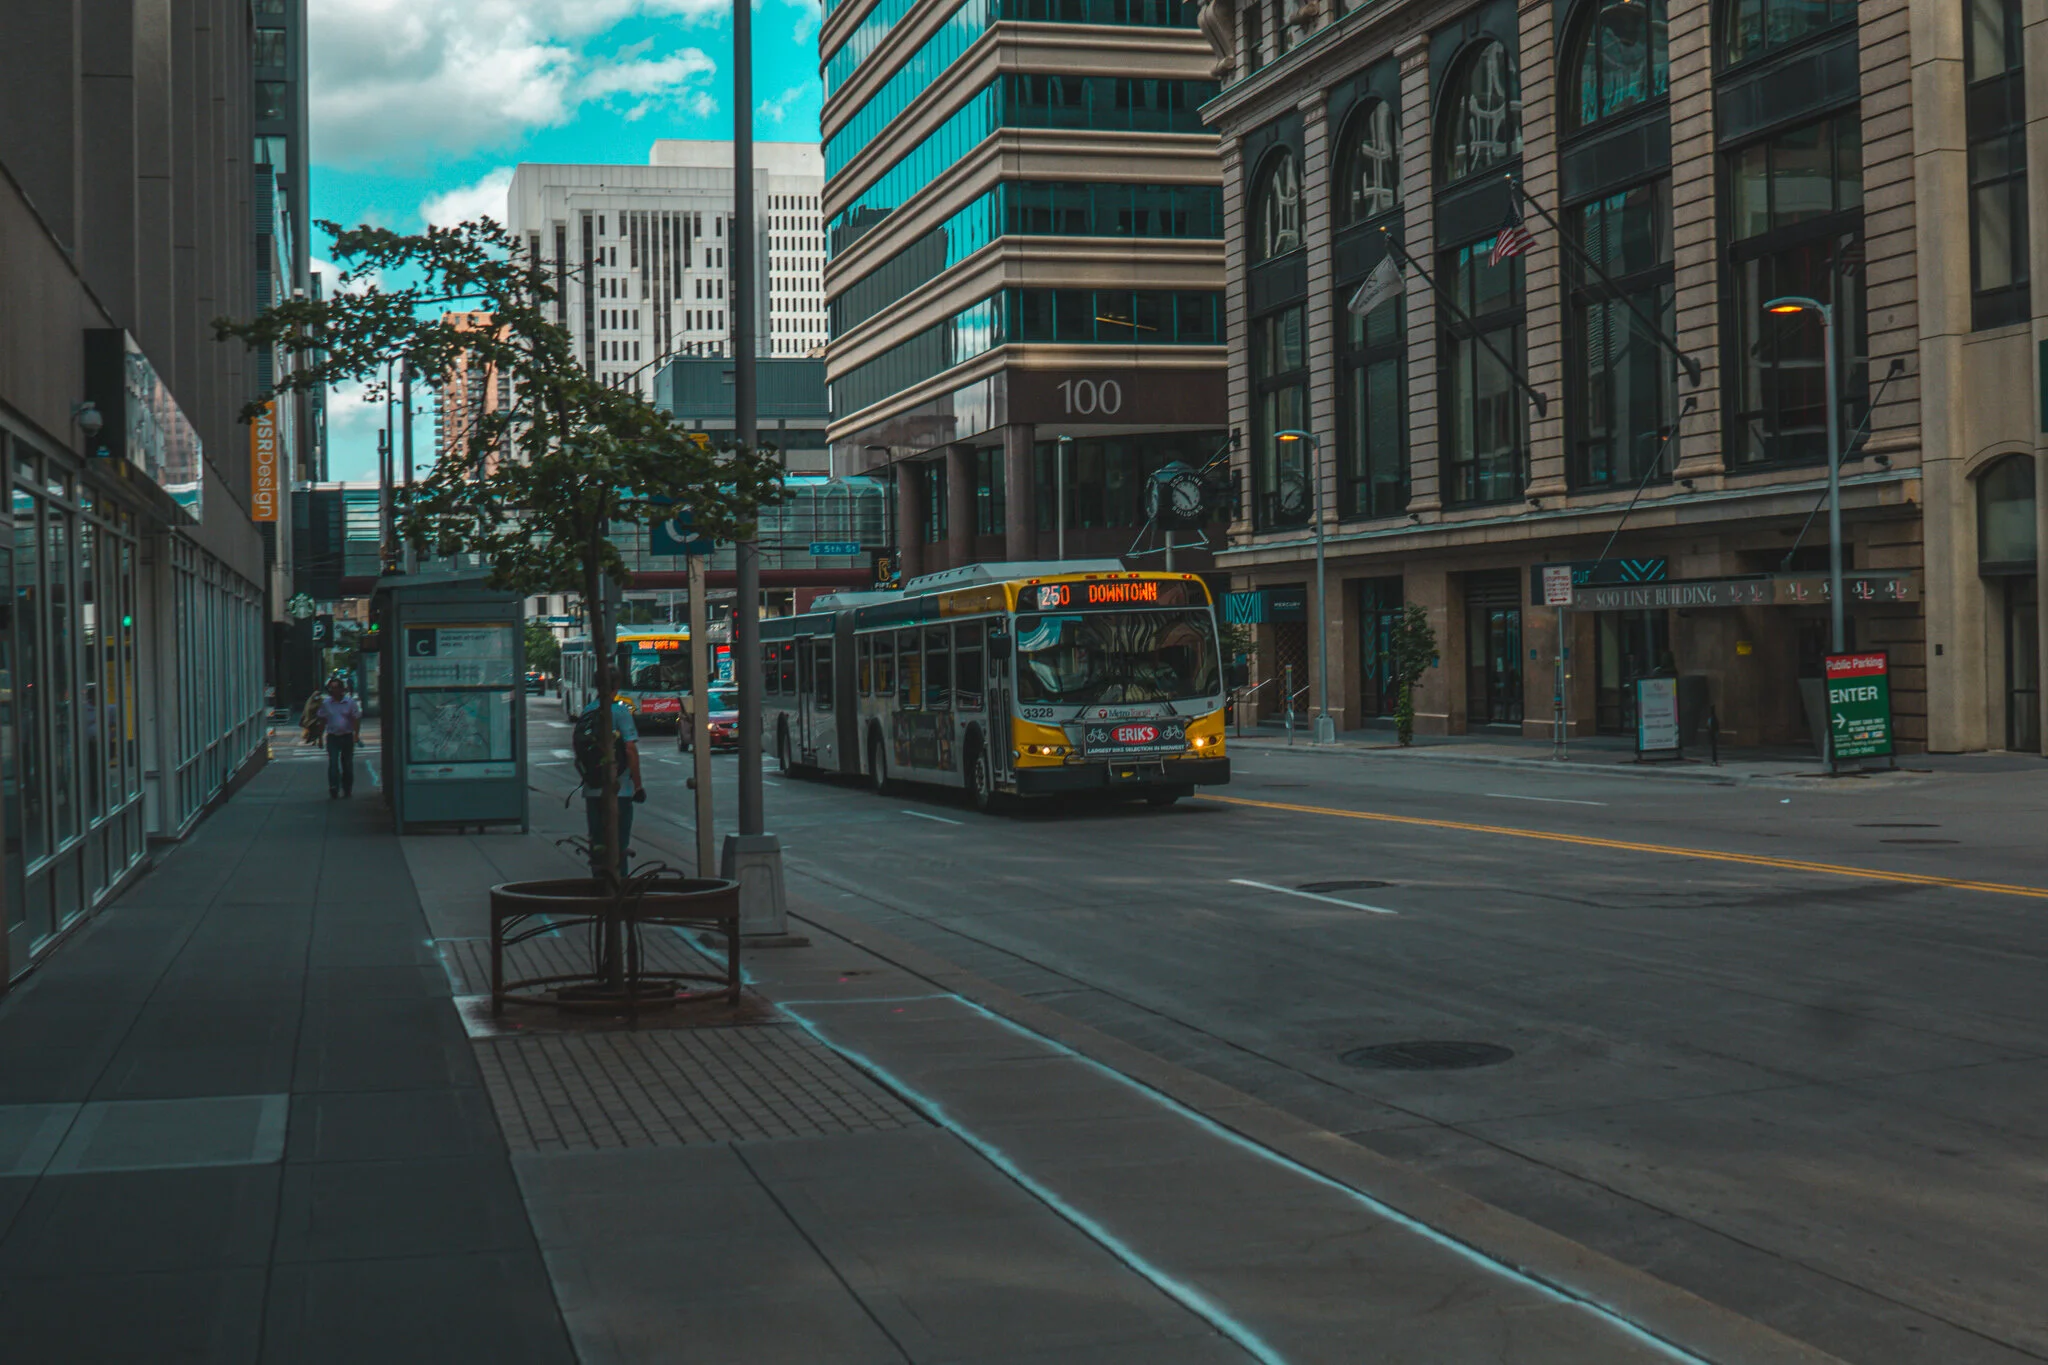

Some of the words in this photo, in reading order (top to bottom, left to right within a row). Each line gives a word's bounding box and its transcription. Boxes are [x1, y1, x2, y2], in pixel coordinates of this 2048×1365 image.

[1057, 379, 1122, 415] 100
[814, 545, 820, 553] S
[824, 545, 841, 553] 5th
[845, 545, 856, 553] St
[1041, 585, 1070, 606] 250
[1088, 582, 1157, 603] DOWNTOWN
[1596, 591, 1620, 607] SOO
[1623, 589, 1649, 606] LINE
[1656, 585, 1717, 605] BUILDING
[416, 640, 430, 655] C
[1826, 659, 1851, 671] Public
[1853, 657, 1883, 669] Parking
[1829, 686, 1878, 704] ENTER
[1023, 708, 1054, 719] 3328
[1118, 727, 1155, 741] ERIK'S
